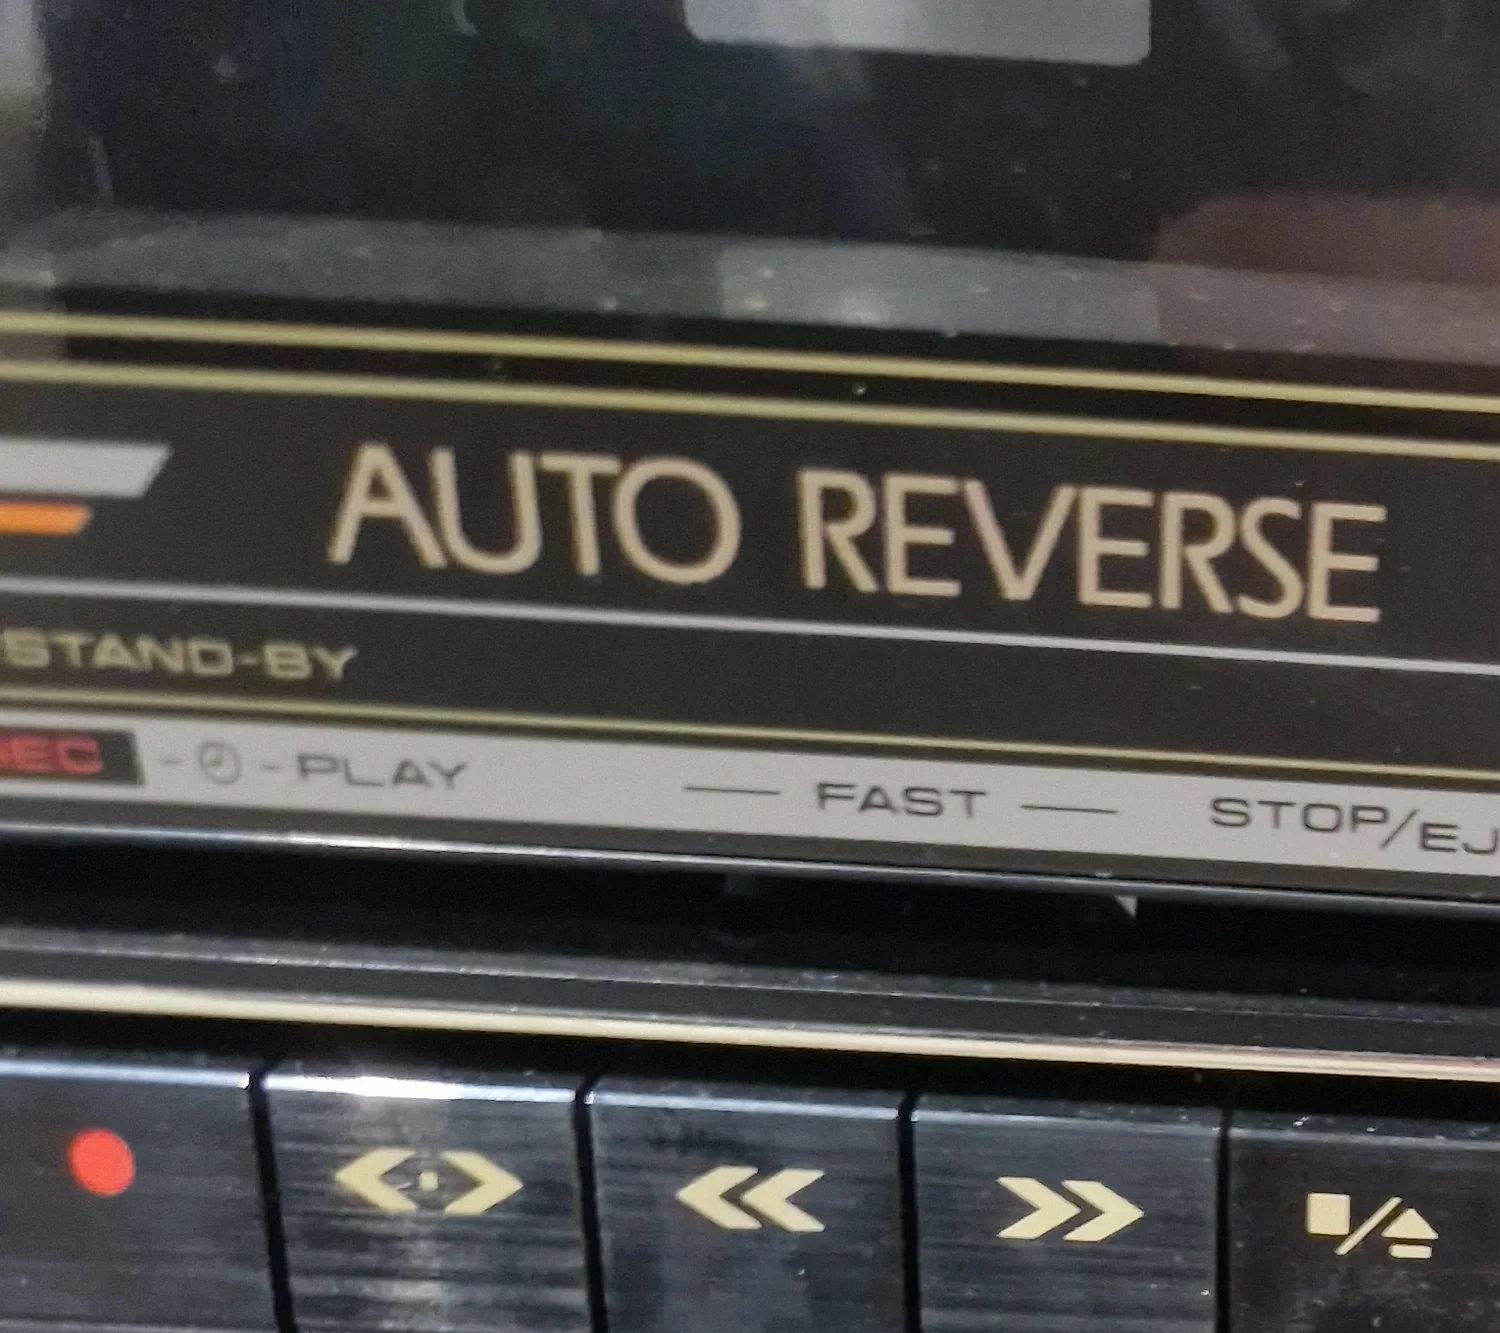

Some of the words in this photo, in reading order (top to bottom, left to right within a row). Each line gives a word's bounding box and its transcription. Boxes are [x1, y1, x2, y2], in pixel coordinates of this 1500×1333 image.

[328, 441, 742, 585] AUTO
[798, 466, 1388, 623] REVERSE
[3, 628, 357, 680] STAND-BY
[0, 734, 103, 774] EC
[299, 753, 467, 790] PLAY
[816, 782, 988, 818] FAST
